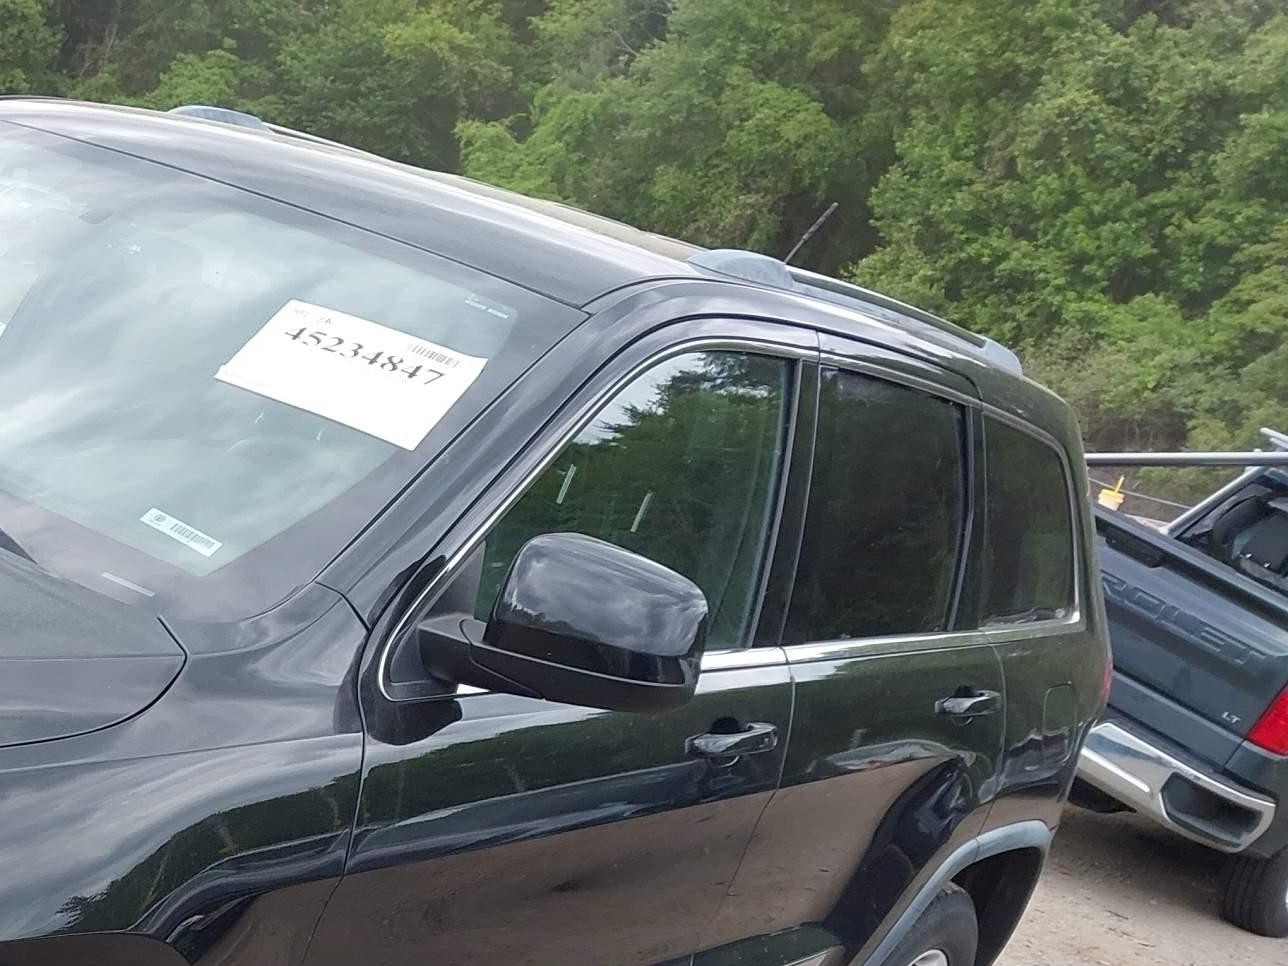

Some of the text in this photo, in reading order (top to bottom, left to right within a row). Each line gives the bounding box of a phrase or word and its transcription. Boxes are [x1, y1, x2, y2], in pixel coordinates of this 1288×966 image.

[283, 326, 445, 385] 45234847
[1100, 568, 1269, 665] ROLET
[1221, 710, 1241, 725] LT
